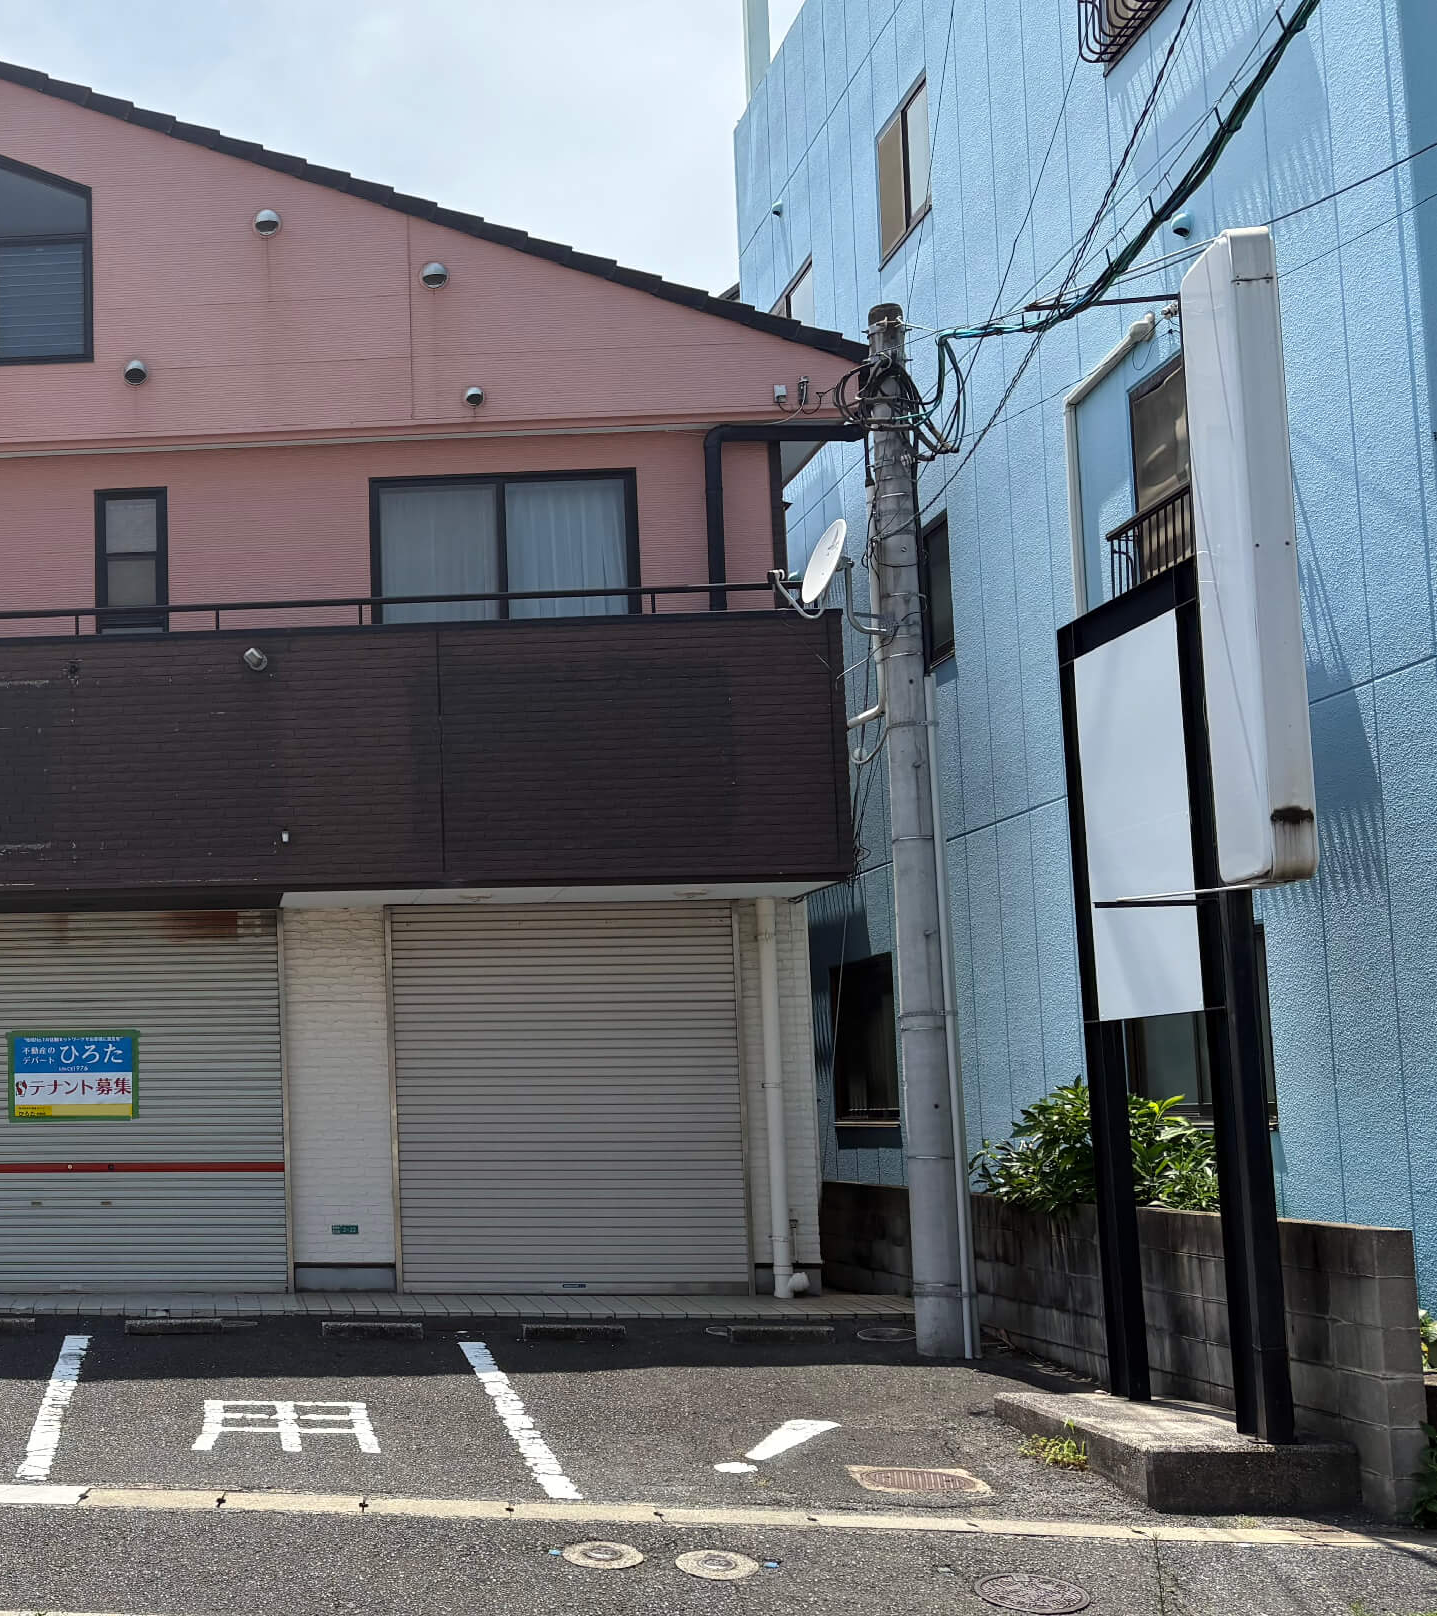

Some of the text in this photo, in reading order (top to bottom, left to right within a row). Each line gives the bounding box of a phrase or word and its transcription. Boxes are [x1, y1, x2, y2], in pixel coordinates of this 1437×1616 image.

[22, 1046, 55, 1055] 不動産の
[60, 1043, 124, 1064] ひろた
[22, 1056, 56, 1065] デパート
[29, 1077, 132, 1096] テナント募集
